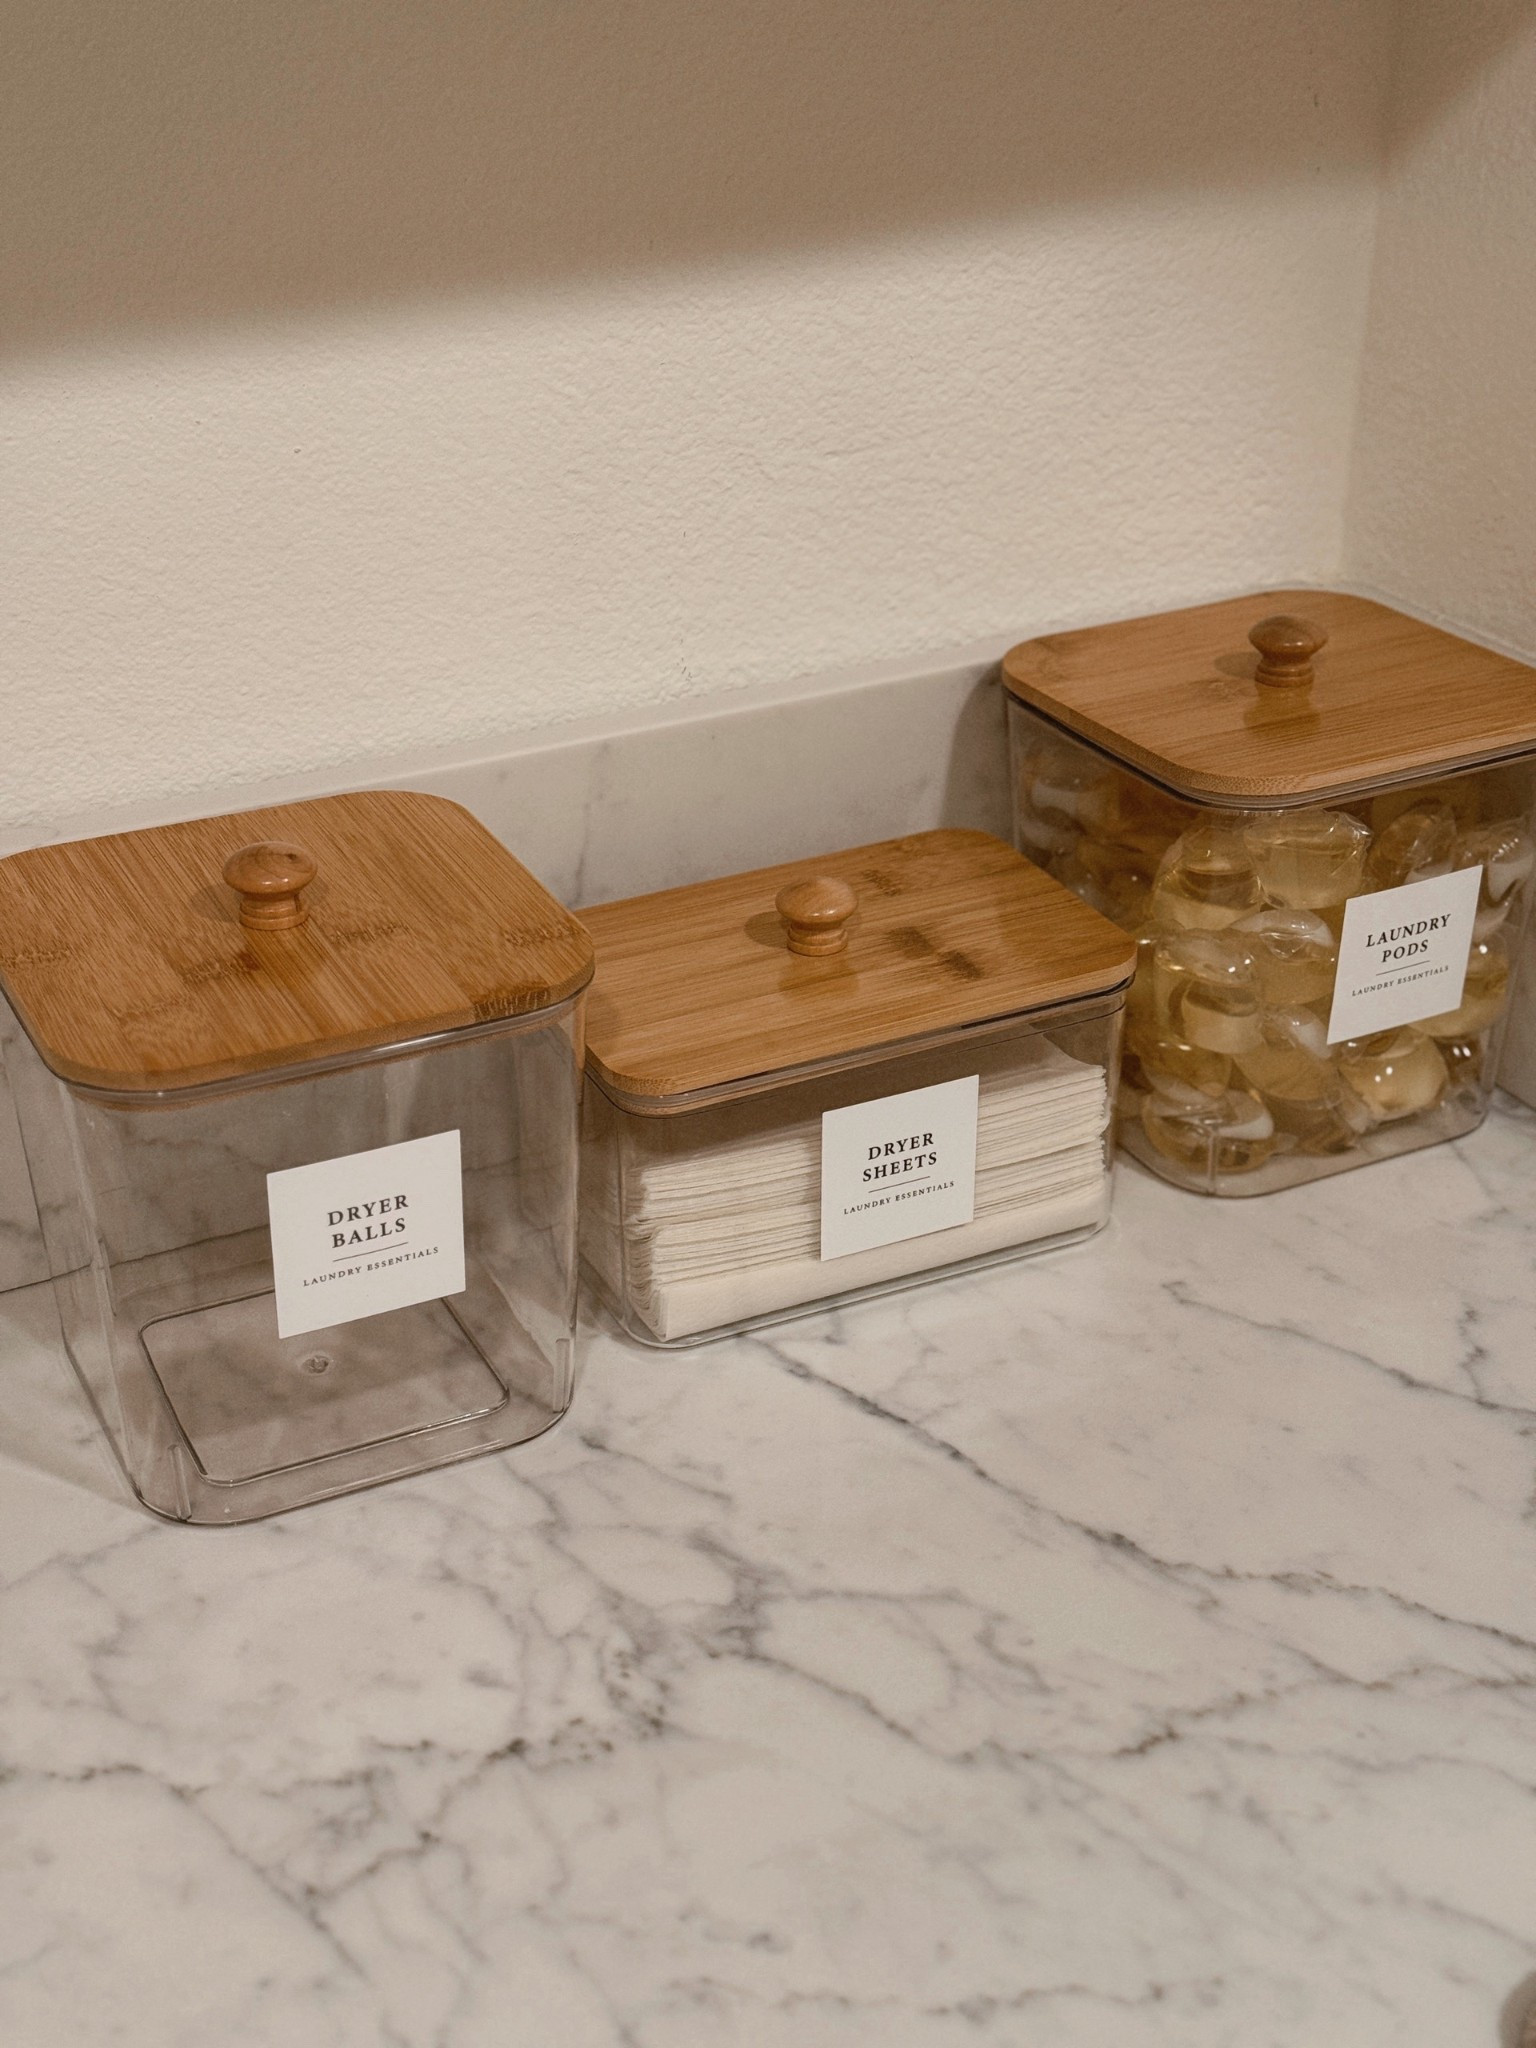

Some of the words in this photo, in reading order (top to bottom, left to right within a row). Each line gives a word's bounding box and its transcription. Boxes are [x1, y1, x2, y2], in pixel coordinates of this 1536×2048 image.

[1366, 914, 1451, 947] LAUNDRY
[1381, 939, 1429, 963] PODS
[1352, 980, 1394, 996] LAUNDRY
[1397, 965, 1449, 985] ESSENTIALS
[868, 1132, 934, 1160] DRYER
[862, 1152, 937, 1182] SHEETS
[327, 1194, 409, 1226] DRYER
[844, 1197, 891, 1215] LAUNDRY
[895, 1181, 955, 1201] ESSENTIALS
[331, 1217, 406, 1248] BALLS
[303, 1266, 362, 1287] LAUNDRY
[367, 1246, 439, 1271] ESSENTIALS
